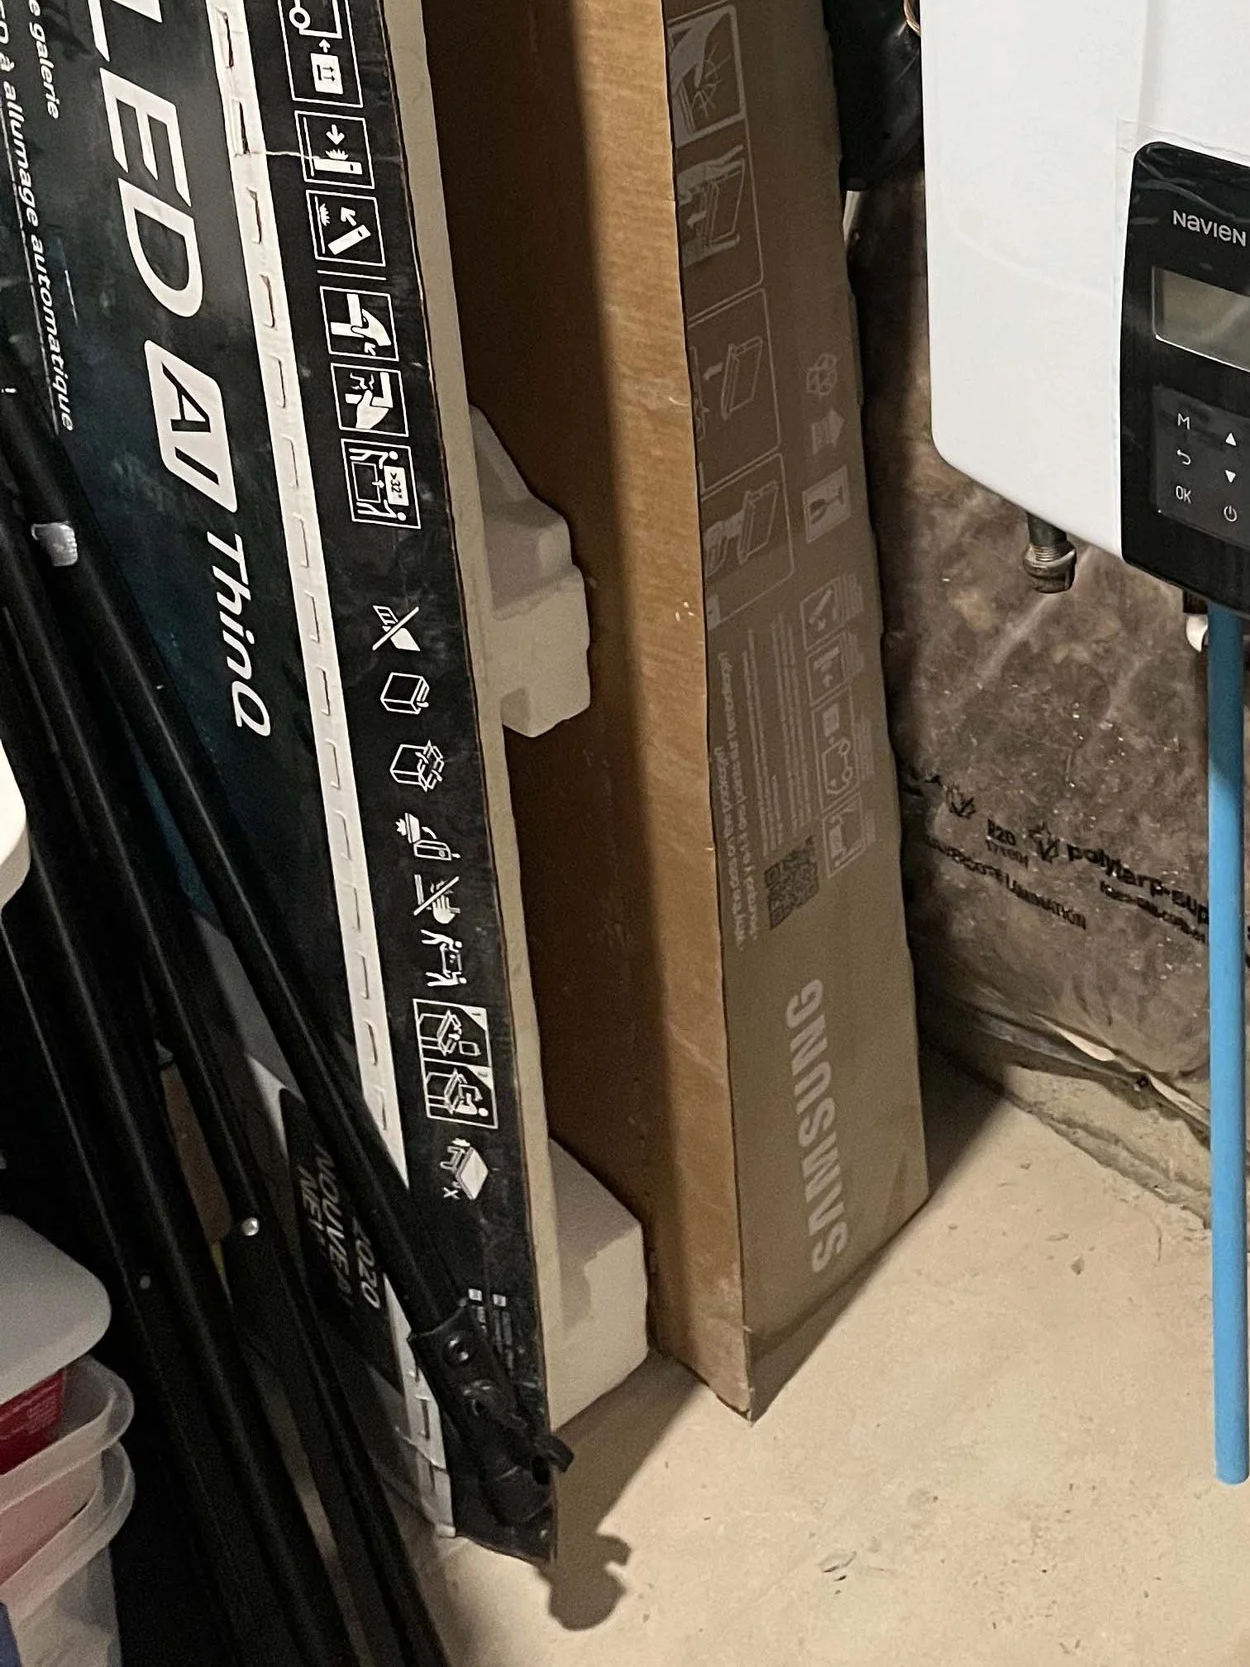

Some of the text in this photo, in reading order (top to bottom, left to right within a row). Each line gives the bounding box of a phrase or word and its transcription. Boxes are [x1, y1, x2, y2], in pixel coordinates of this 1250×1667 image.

[29, 22, 60, 119] galerie
[4, 81, 39, 226] allumage
[31, 235, 74, 431] automatique
[1175, 485, 1191, 504] OK
[1178, 413, 1190, 430] M
[201, 531, 271, 737] ThinQ
[786, 979, 848, 1273] SAMSUNG
